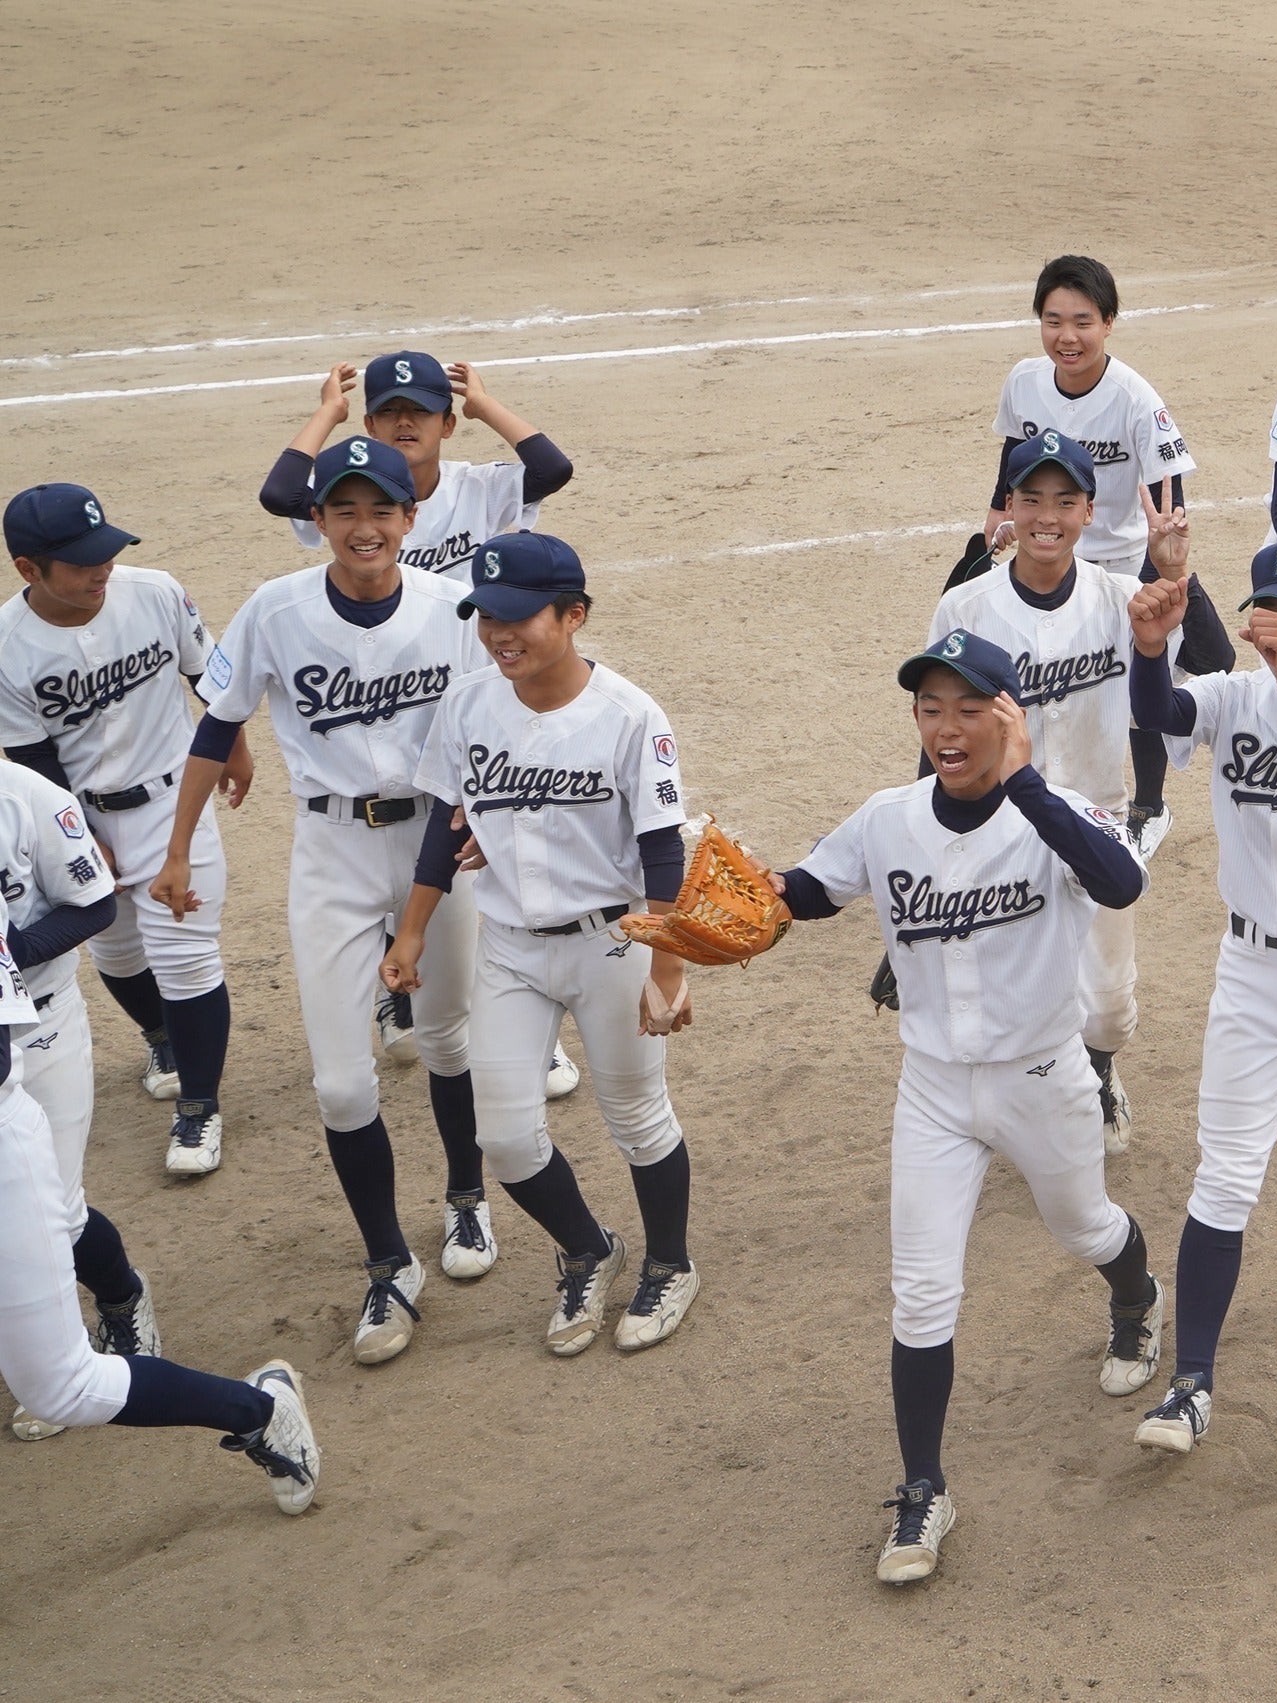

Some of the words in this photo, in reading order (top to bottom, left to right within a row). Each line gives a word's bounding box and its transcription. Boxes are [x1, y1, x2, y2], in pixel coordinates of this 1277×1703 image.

[395, 360, 413, 384] S
[348, 440, 369, 466] S
[1042, 431, 1060, 455] S
[85, 500, 101, 528] S
[485, 551, 501, 580] S
[942, 633, 965, 658] S
[34, 641, 173, 726] Sluggers
[1017, 645, 1126, 706] luggers
[294, 663, 453, 738] Sluggers
[463, 744, 613, 817] Sluggers
[887, 869, 1045, 951] Sluggers
